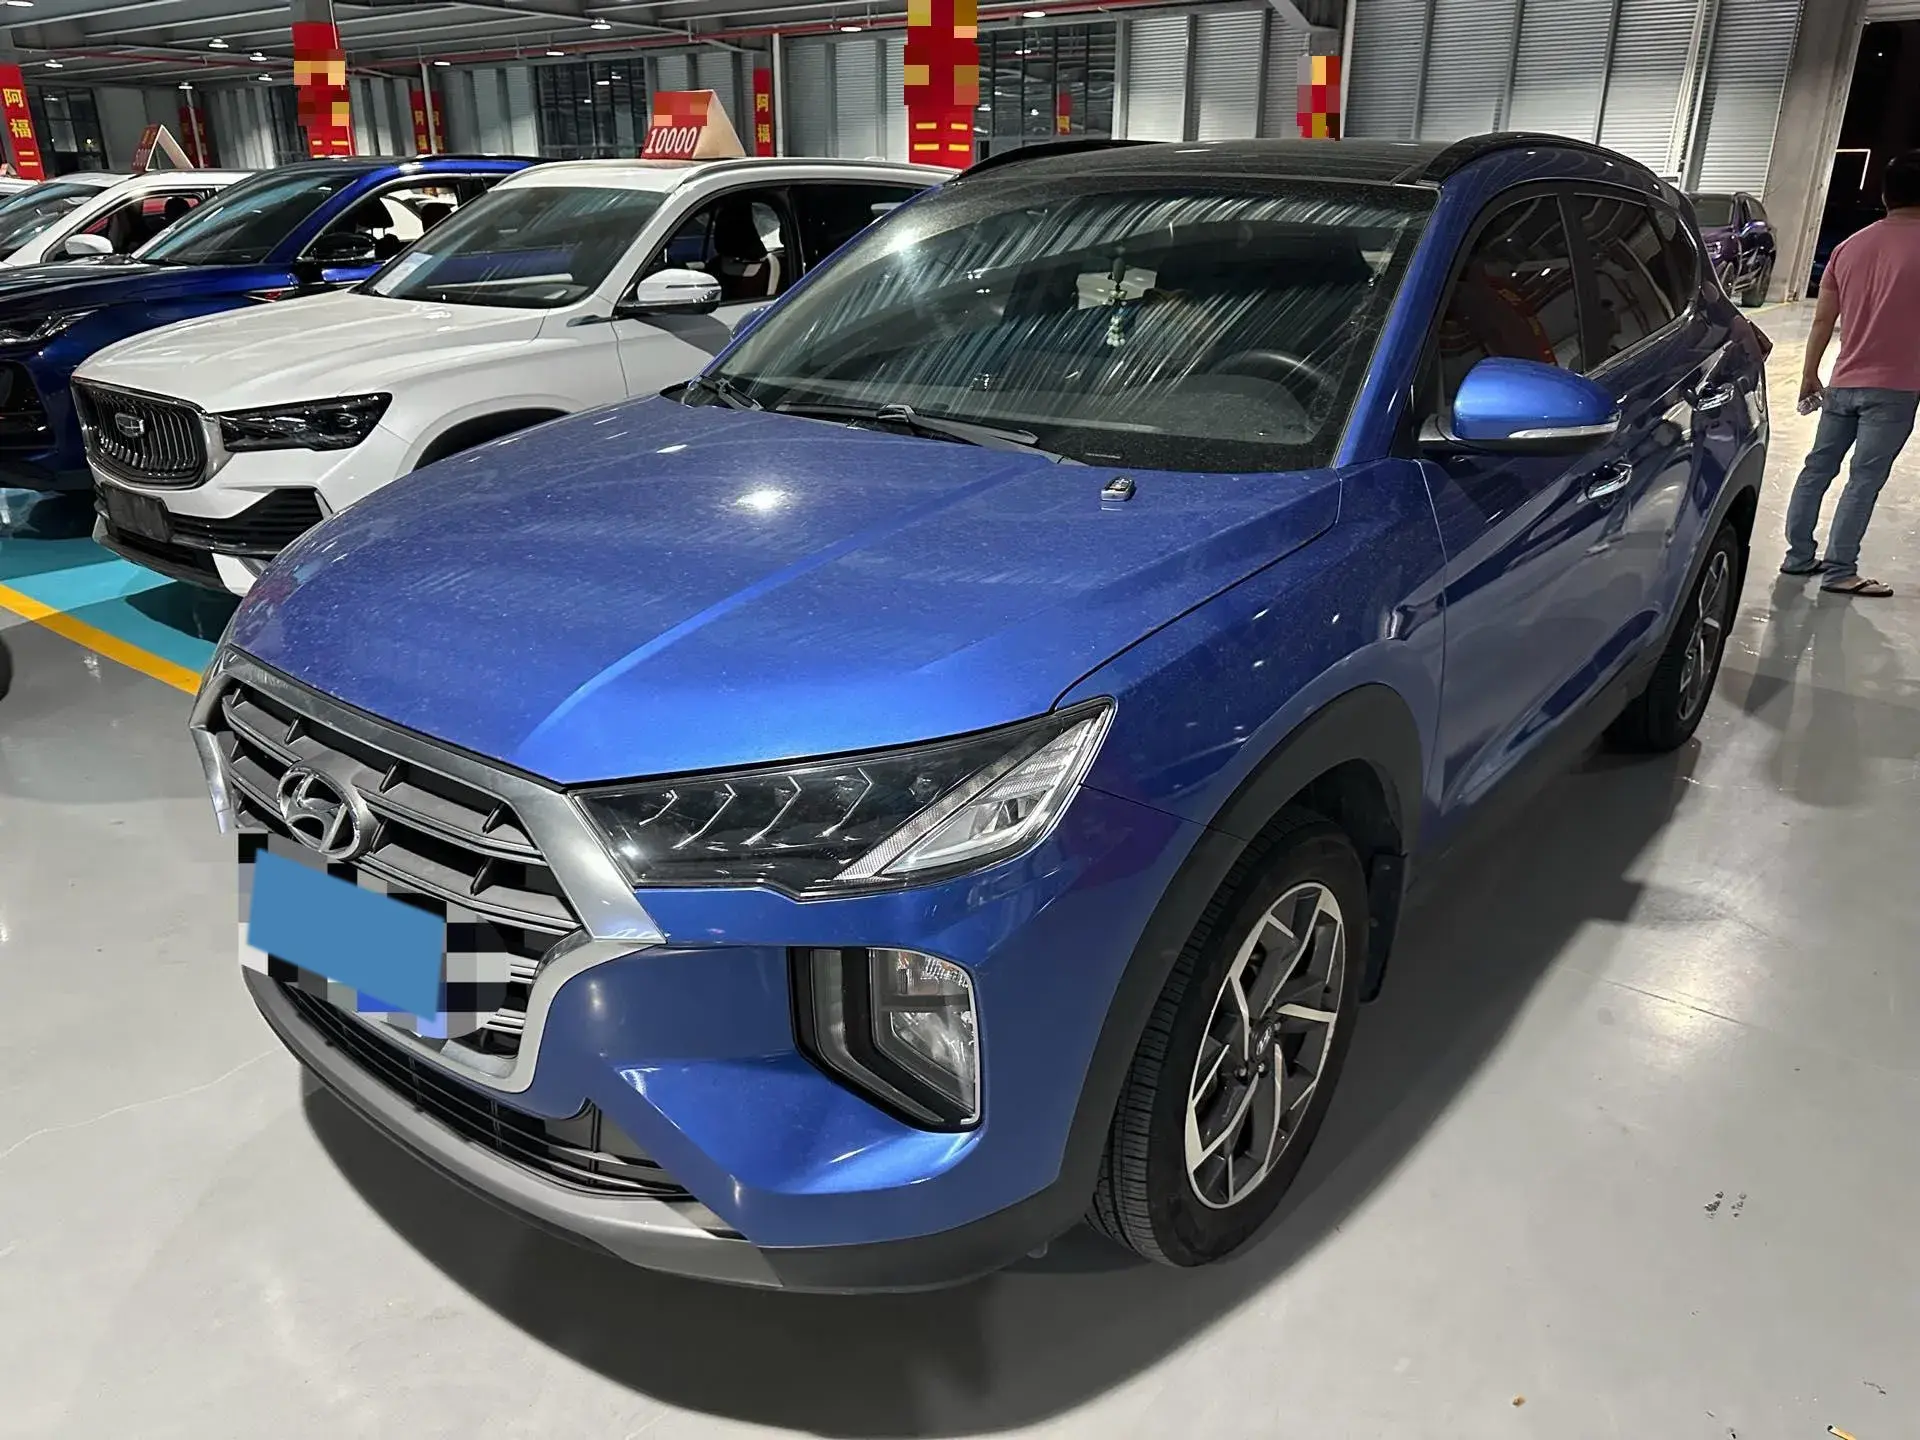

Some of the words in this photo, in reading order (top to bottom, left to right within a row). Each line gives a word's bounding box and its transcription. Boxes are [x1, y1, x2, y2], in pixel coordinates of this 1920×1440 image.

[3, 88, 39, 166] 阿福二
[644, 127, 698, 154] 10000
